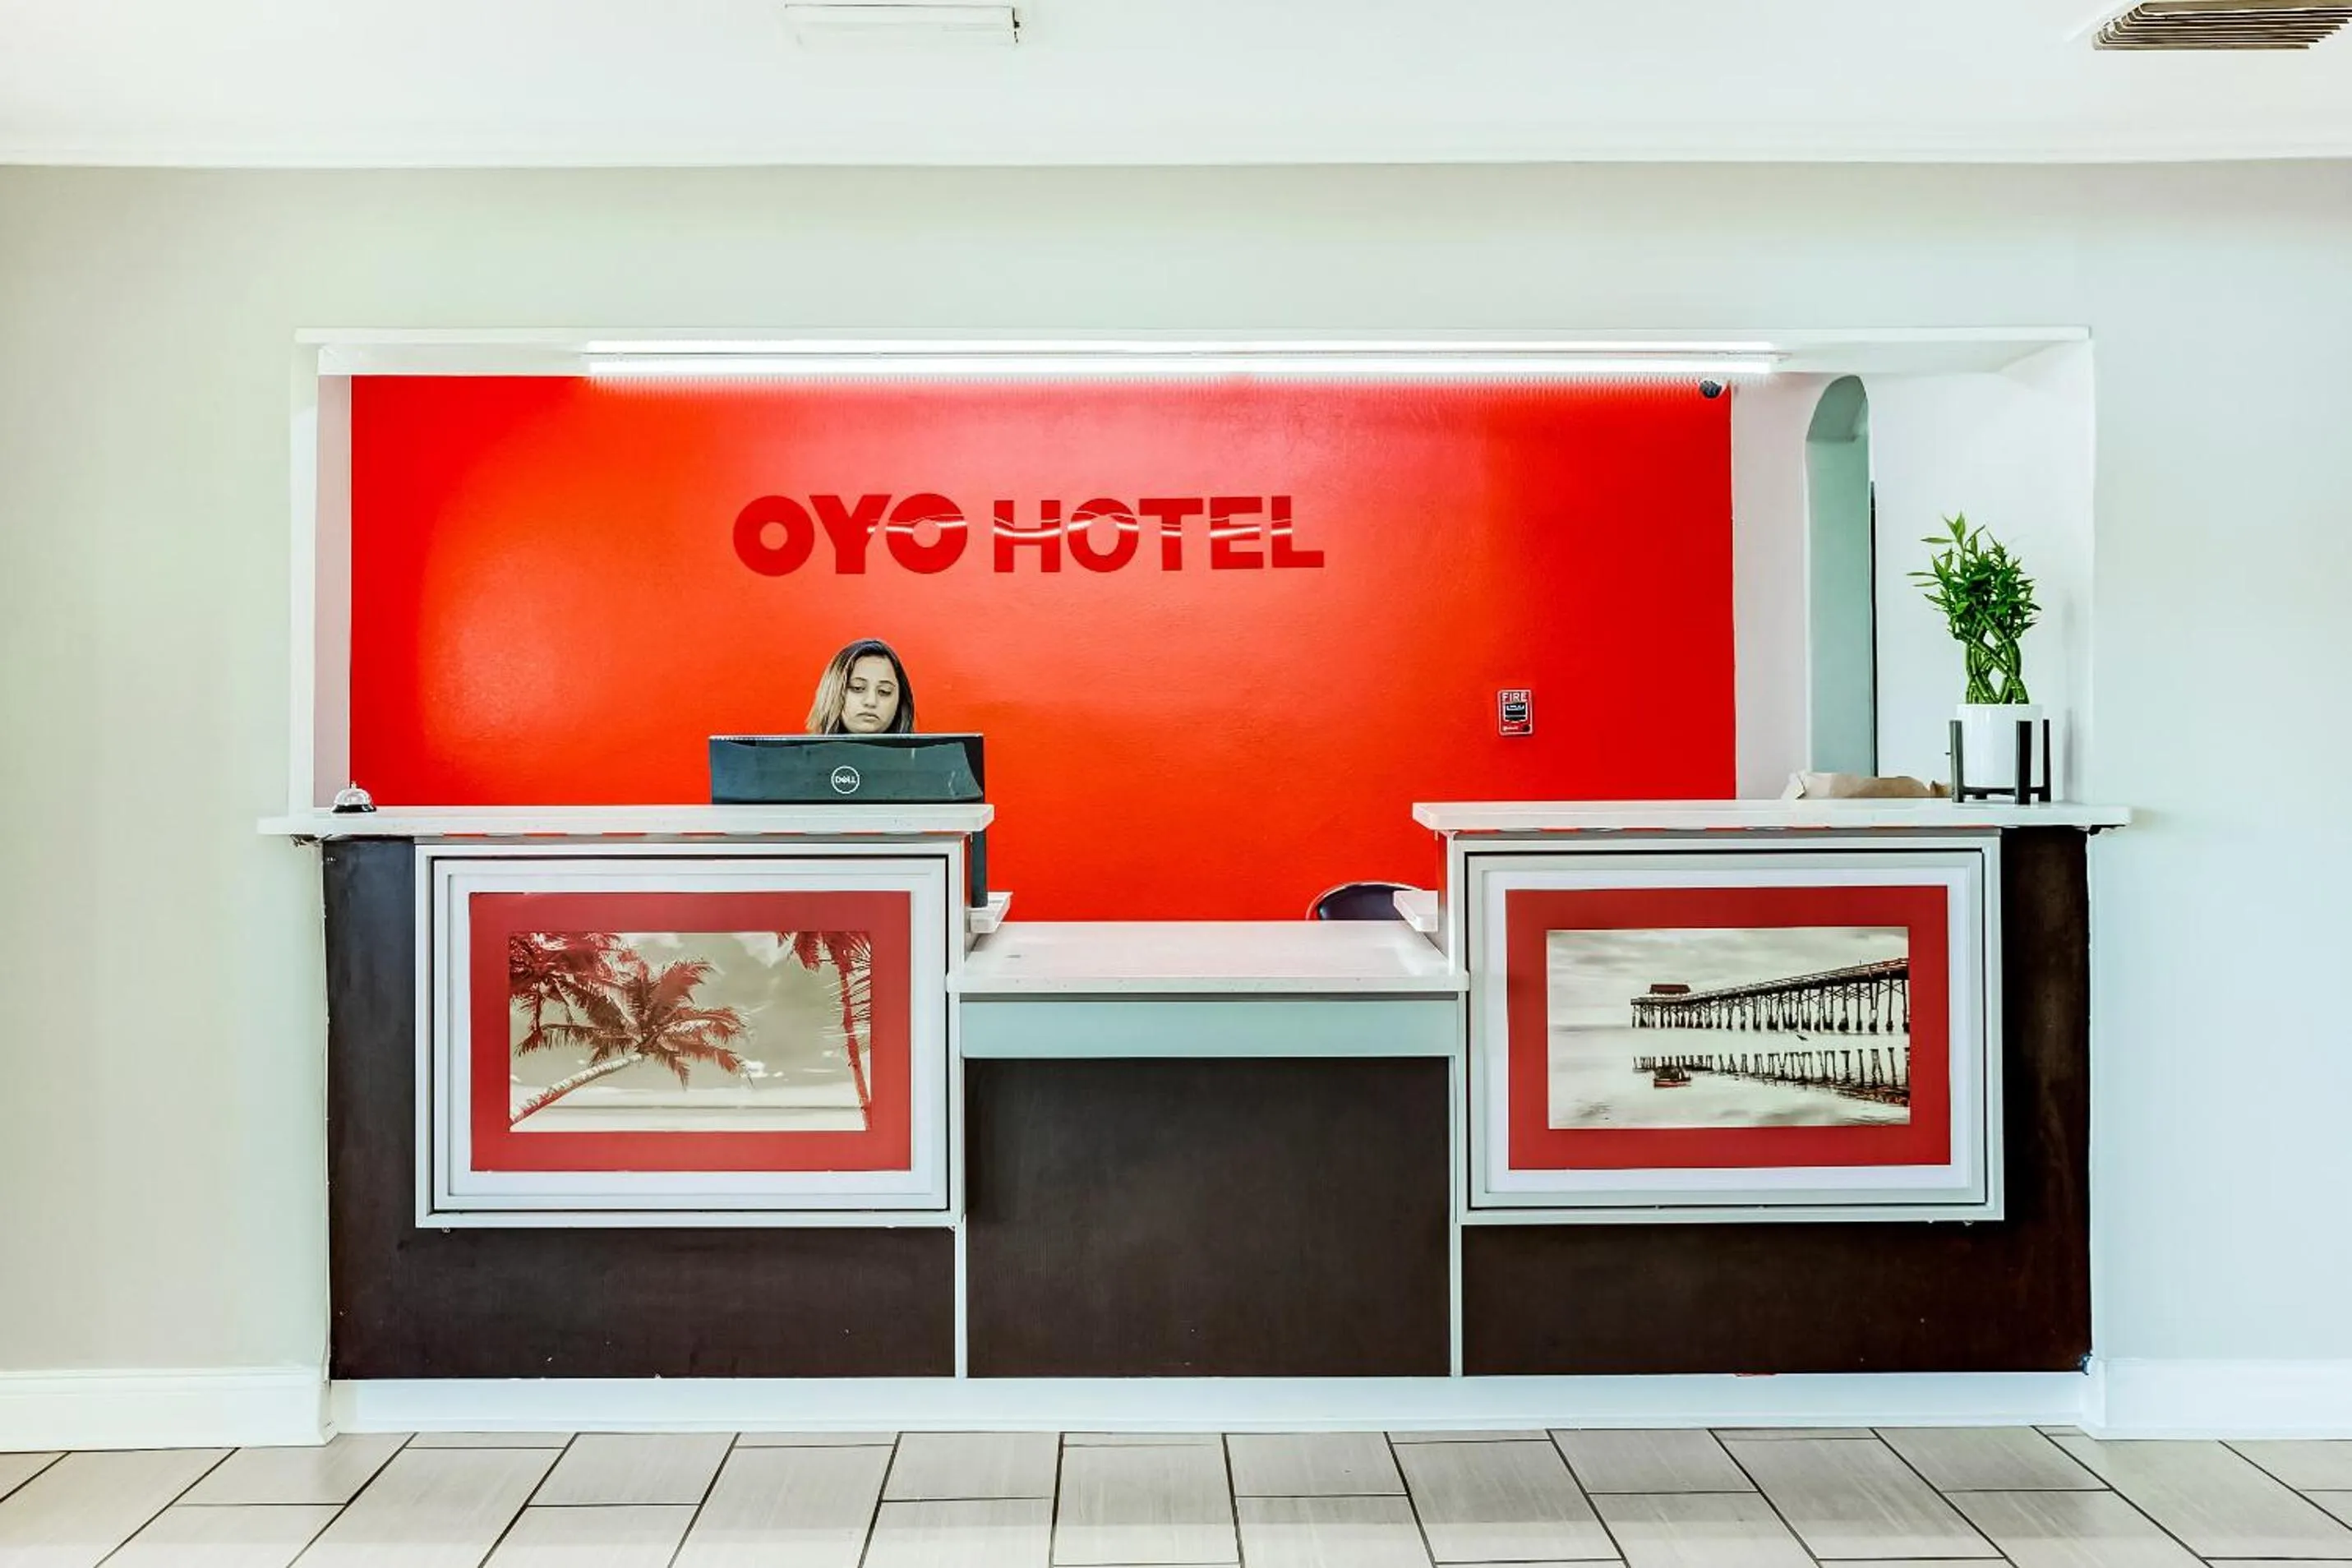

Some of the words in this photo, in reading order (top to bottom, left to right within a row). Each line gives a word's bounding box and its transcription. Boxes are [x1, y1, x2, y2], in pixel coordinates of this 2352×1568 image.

[733, 493, 968, 576] OYO
[993, 496, 1325, 573] HOTEL
[1501, 692, 1528, 703] FIRE
[835, 775, 856, 784] DELL
